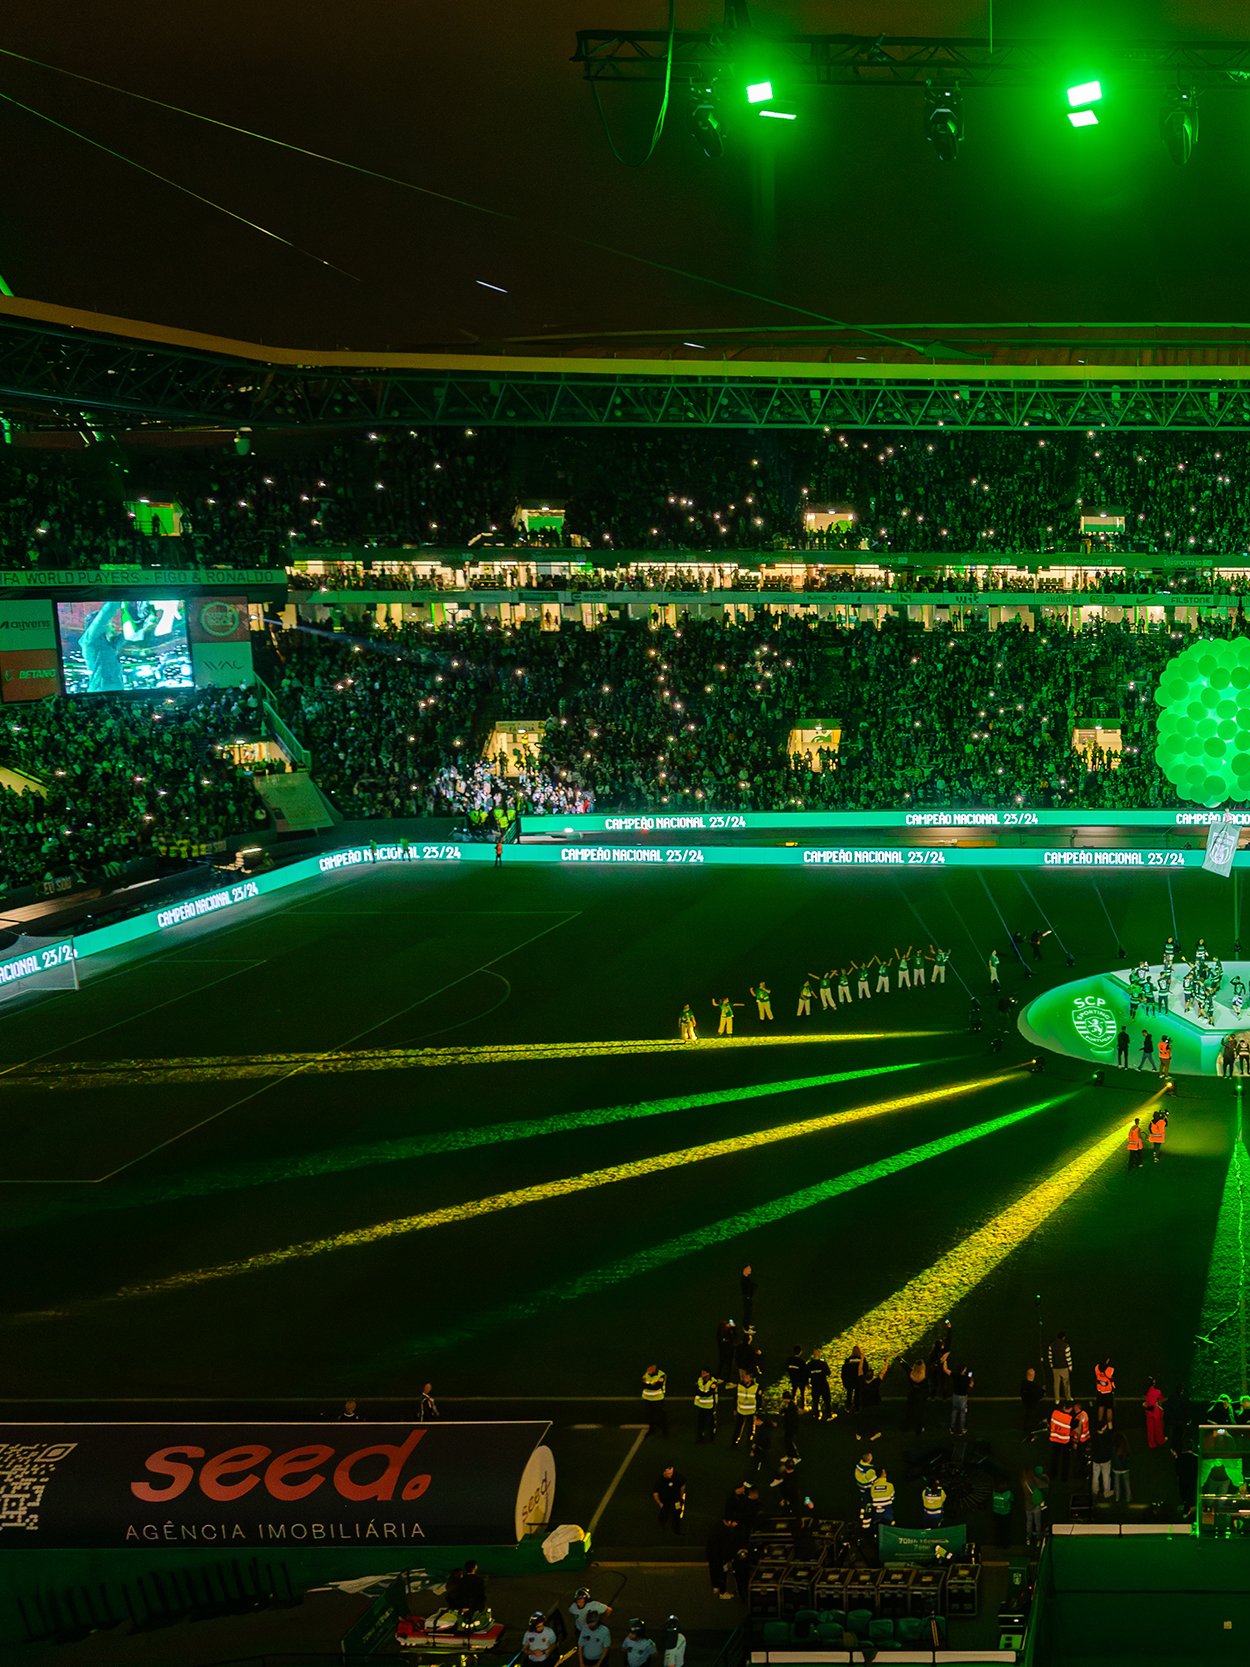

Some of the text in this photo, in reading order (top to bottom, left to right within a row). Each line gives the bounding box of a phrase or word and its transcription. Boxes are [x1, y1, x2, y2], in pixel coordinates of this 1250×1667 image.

[25, 572, 73, 585] WORLD
[79, 572, 140, 583] PLAYERS
[154, 572, 189, 584] FIGO
[207, 571, 273, 583] RONALDO
[956, 595, 979, 604] wit
[605, 816, 746, 830] CAMPEÃO NACIONAL 23/24
[905, 812, 1038, 825] CAMPEÃO NACIONAL 23/24
[319, 850, 361, 871] CAMPEÃO
[422, 846, 461, 860] 23/24
[561, 847, 704, 862] CAMPEÃO NACIONAL 23/24
[803, 850, 945, 864] CAMPEÃO NACIONAL 23/24
[1044, 850, 1184, 865] CAMPEÃO NACIONAL 23/24
[157, 881, 258, 928] CAMPEÃO NACIONAL 23/24
[1073, 996, 1106, 1009] SCP
[131, 1429, 432, 1502] seed.
[126, 1517, 426, 1541] AGÊNCIA IMOBILIÁRIA
